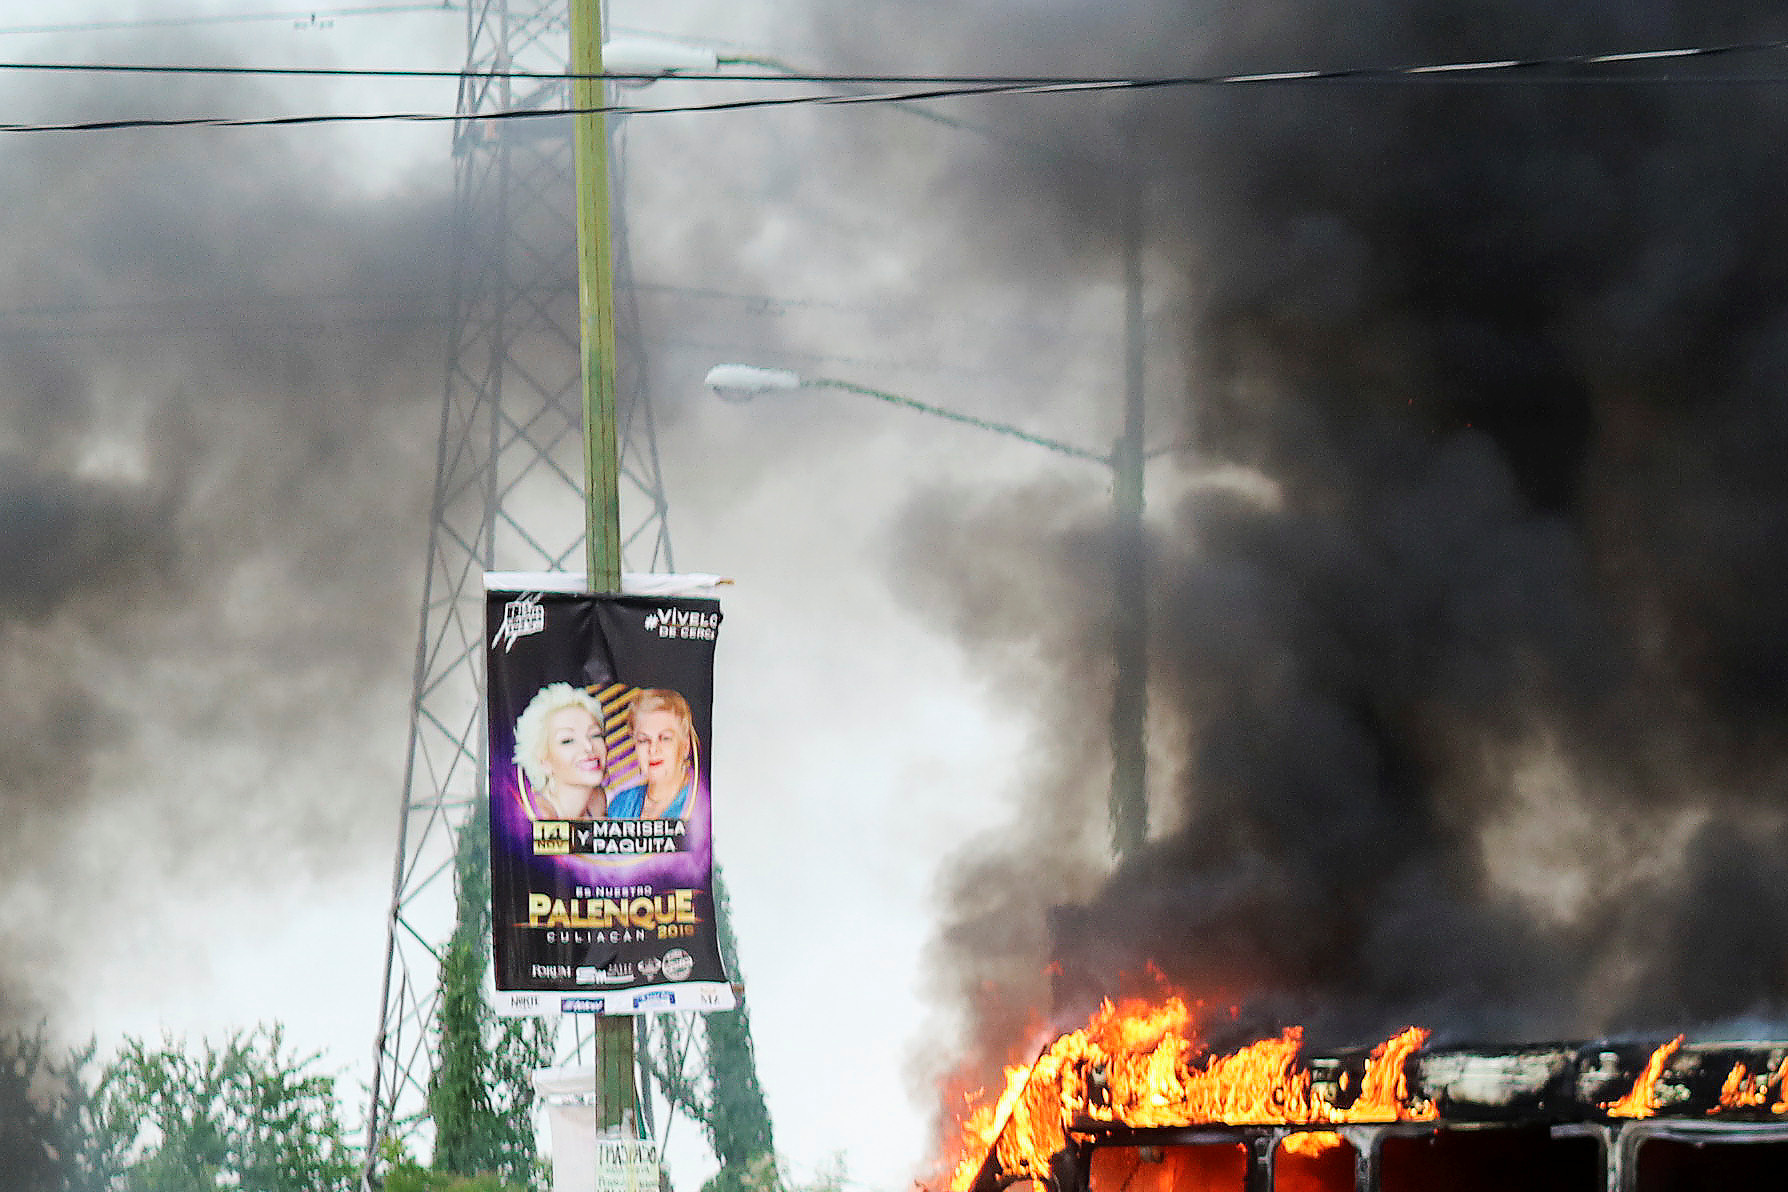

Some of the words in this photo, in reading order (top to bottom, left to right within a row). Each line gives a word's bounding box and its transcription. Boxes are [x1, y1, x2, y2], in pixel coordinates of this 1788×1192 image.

[577, 829, 590, 847] Y
[593, 820, 685, 838] MARISELA
[593, 837, 676, 853] PAQUITA
[528, 889, 696, 930] PALENQUE
